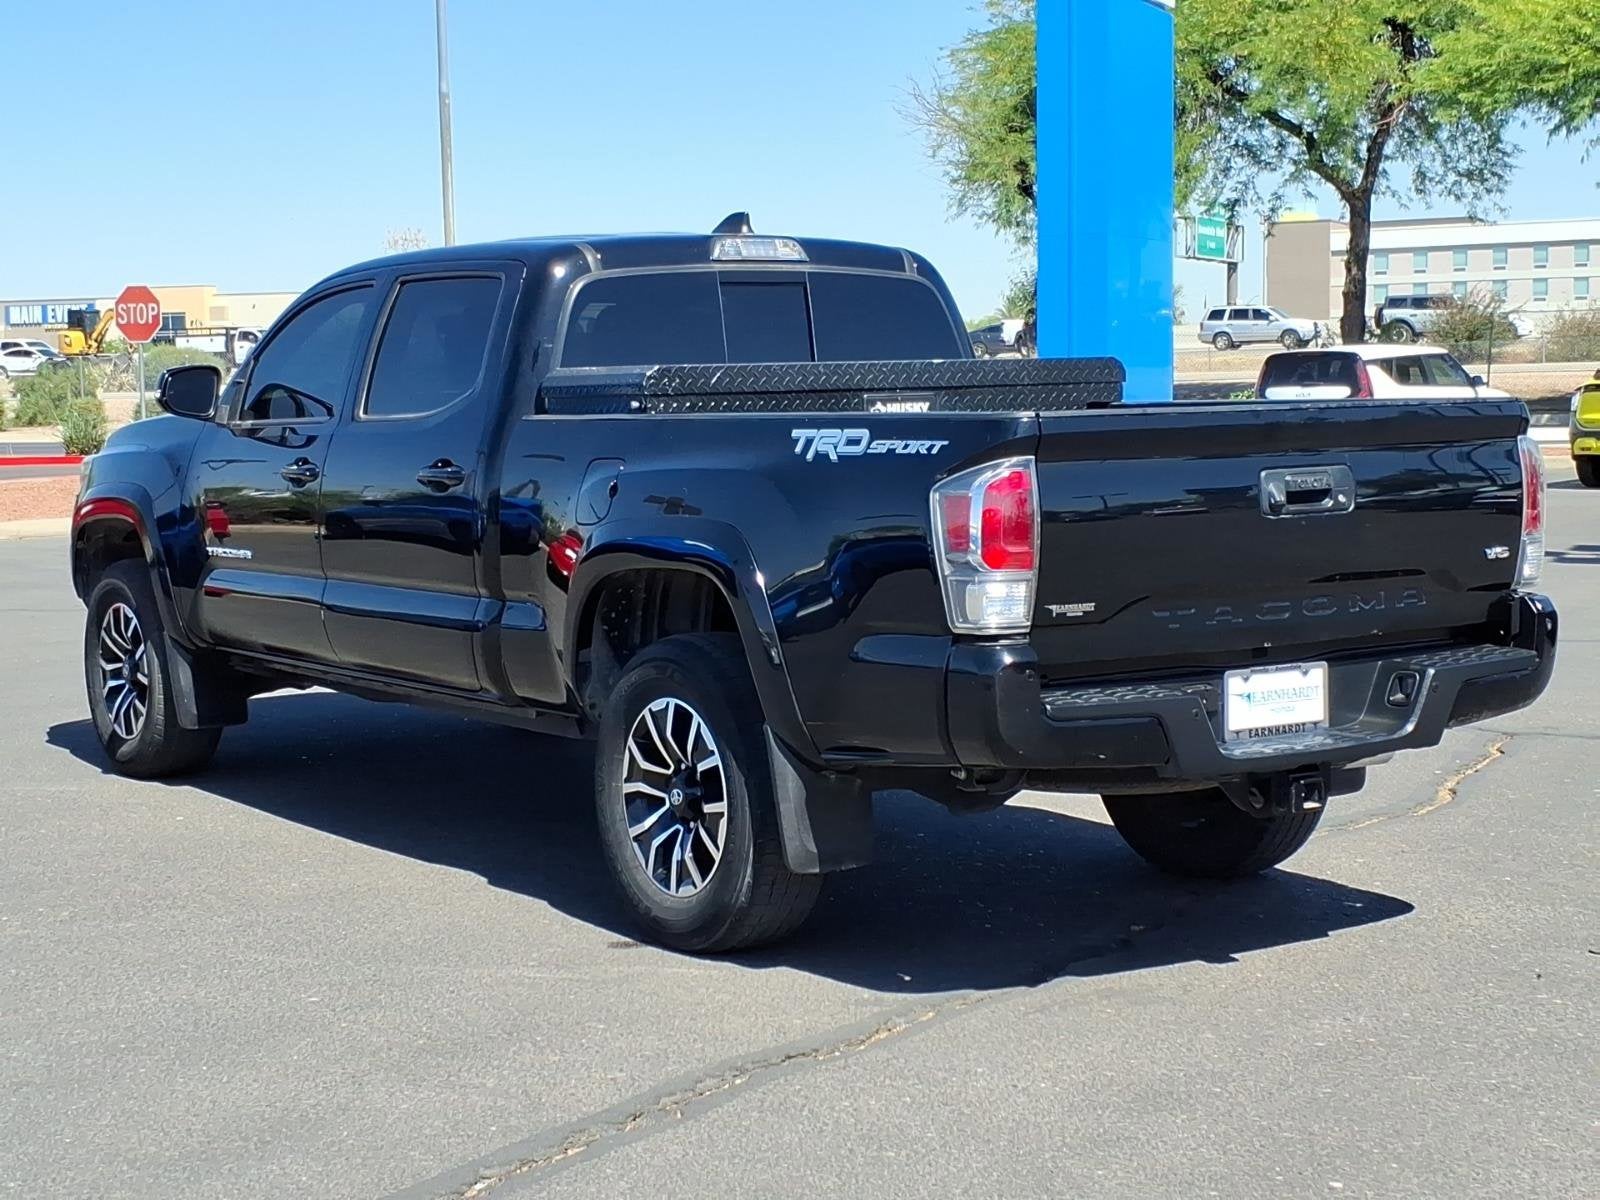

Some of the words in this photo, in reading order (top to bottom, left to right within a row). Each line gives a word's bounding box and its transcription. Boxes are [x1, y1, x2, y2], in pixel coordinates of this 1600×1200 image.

[9, 305, 43, 324] MAIN
[117, 303, 158, 325] STOP
[887, 402, 930, 413] HUSKY
[791, 428, 870, 463] TRD
[867, 440, 950, 454] SPORT
[1484, 546, 1510, 559] V6
[1152, 590, 1427, 628] TACOMA
[1251, 685, 1320, 704] EARNHARDT
[1248, 722, 1307, 739] EARNHARDT
